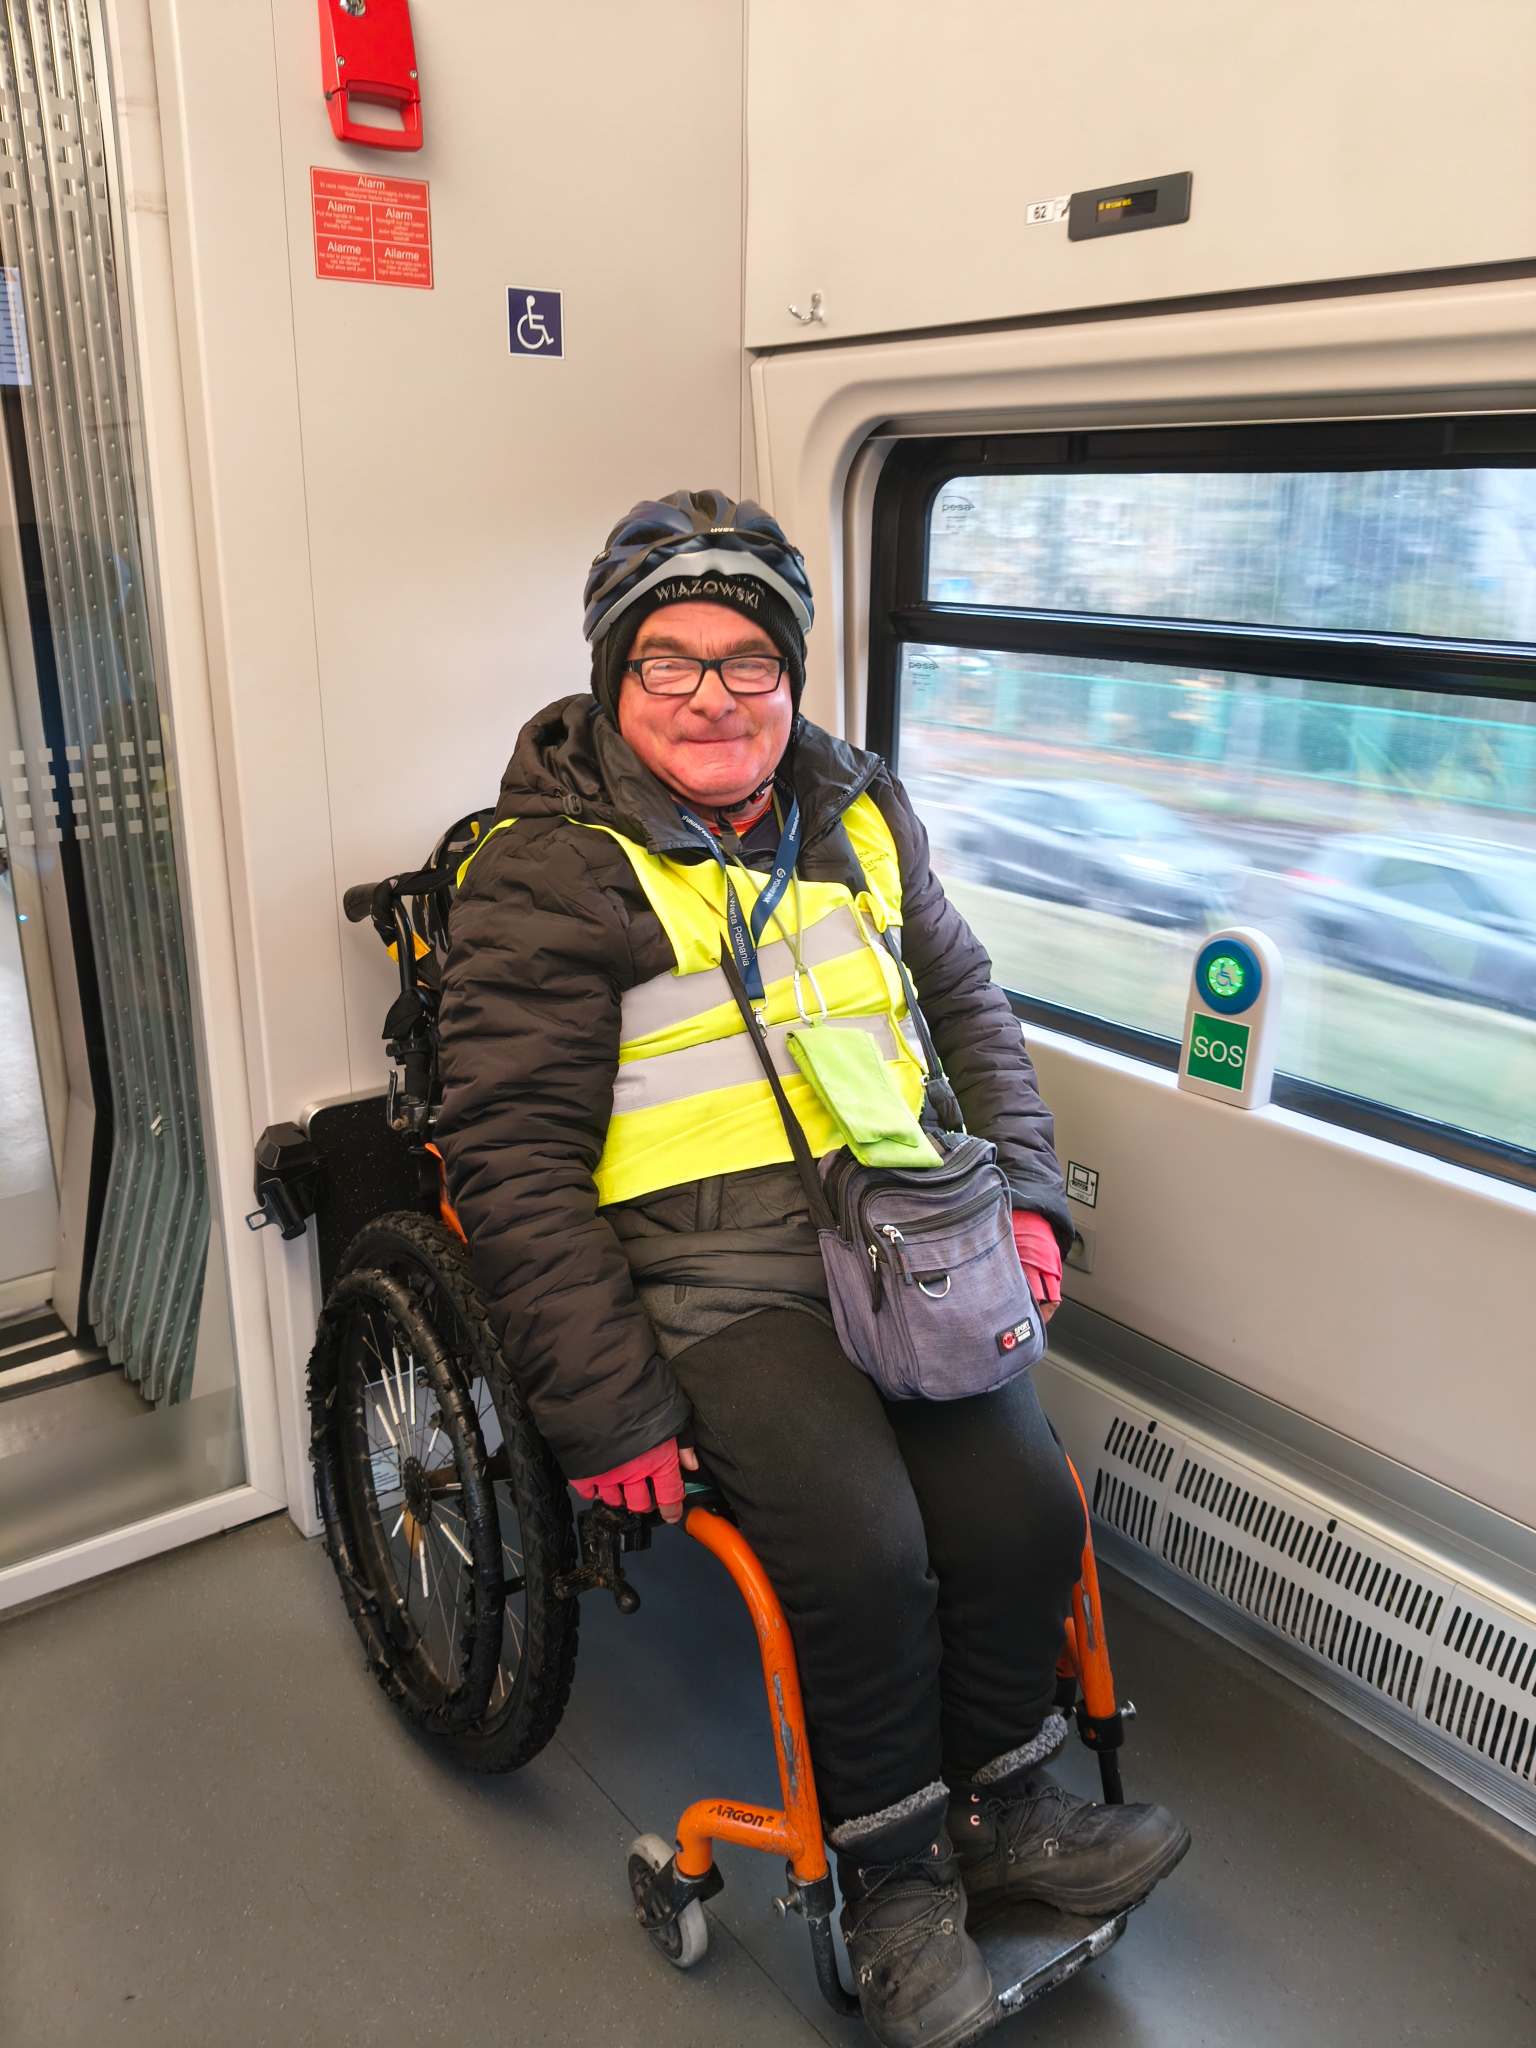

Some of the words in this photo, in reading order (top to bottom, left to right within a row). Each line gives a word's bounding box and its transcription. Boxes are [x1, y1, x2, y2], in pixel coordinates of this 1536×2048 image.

[357, 176, 385, 190] Alarm
[327, 200, 356, 213] Alarm
[1033, 206, 1046, 220] 62
[385, 208, 413, 220] Alarm
[327, 241, 362, 255] Alarme
[384, 248, 420, 262] Allarme
[733, 926, 751, 967] Poznania
[1193, 1035, 1243, 1068] SOS
